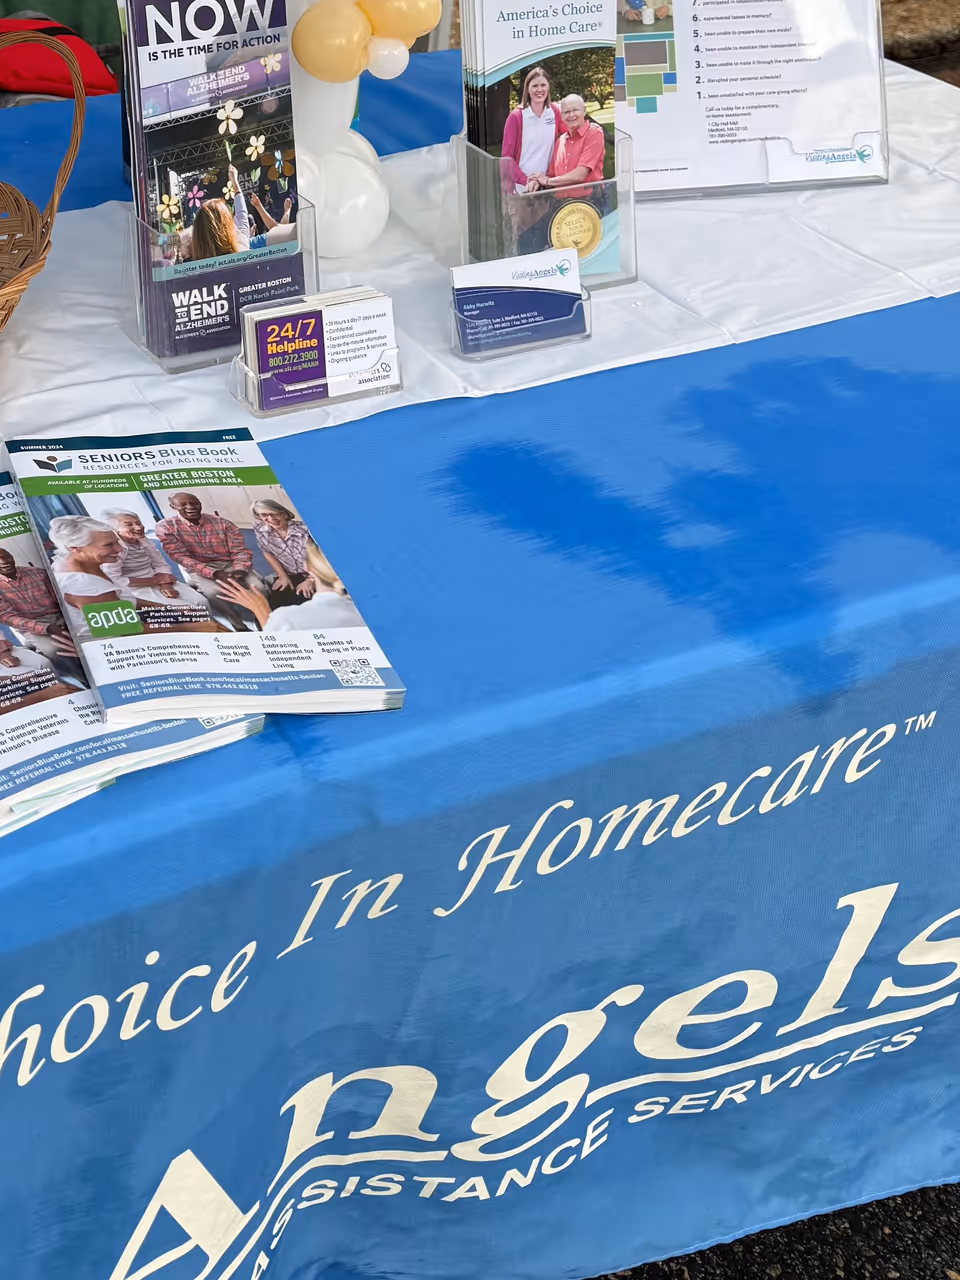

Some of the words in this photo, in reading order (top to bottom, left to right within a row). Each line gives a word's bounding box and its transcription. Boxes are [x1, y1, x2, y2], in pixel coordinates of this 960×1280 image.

[562, 2, 602, 15] Choice
[512, 27, 524, 39] in
[529, 24, 566, 38] Home
[148, 50, 159, 62] IS
[161, 47, 183, 58] THE
[187, 42, 213, 56] TIME
[217, 39, 238, 52] FOR
[242, 34, 280, 48] ACTION
[189, 72, 216, 86] WALK
[225, 66, 245, 77] END
[199, 261, 216, 270] today!
[239, 282, 266, 293] GREATER
[268, 277, 291, 287] BOSTON
[254, 292, 269, 301] North
[287, 285, 299, 293] Park
[172, 283, 227, 308] WALK
[190, 298, 229, 320] END
[175, 315, 230, 331] ALZHEIMER'S
[267, 319, 315, 342] 24/7
[268, 338, 318, 354] Helpline
[269, 350, 318, 367] 800.272.3900
[358, 375, 390, 384] association
[78, 450, 156, 464] SENIORS
[159, 448, 196, 458] Blue
[198, 447, 238, 456] Book
[82, 462, 148, 470] RESOURCES
[140, 472, 188, 481] GREATER
[191, 470, 234, 478] BOSTON
[162, 479, 220, 487] SURROUNDING
[276, 868, 405, 960] In
[628, 1023, 924, 1125] SERVICES
